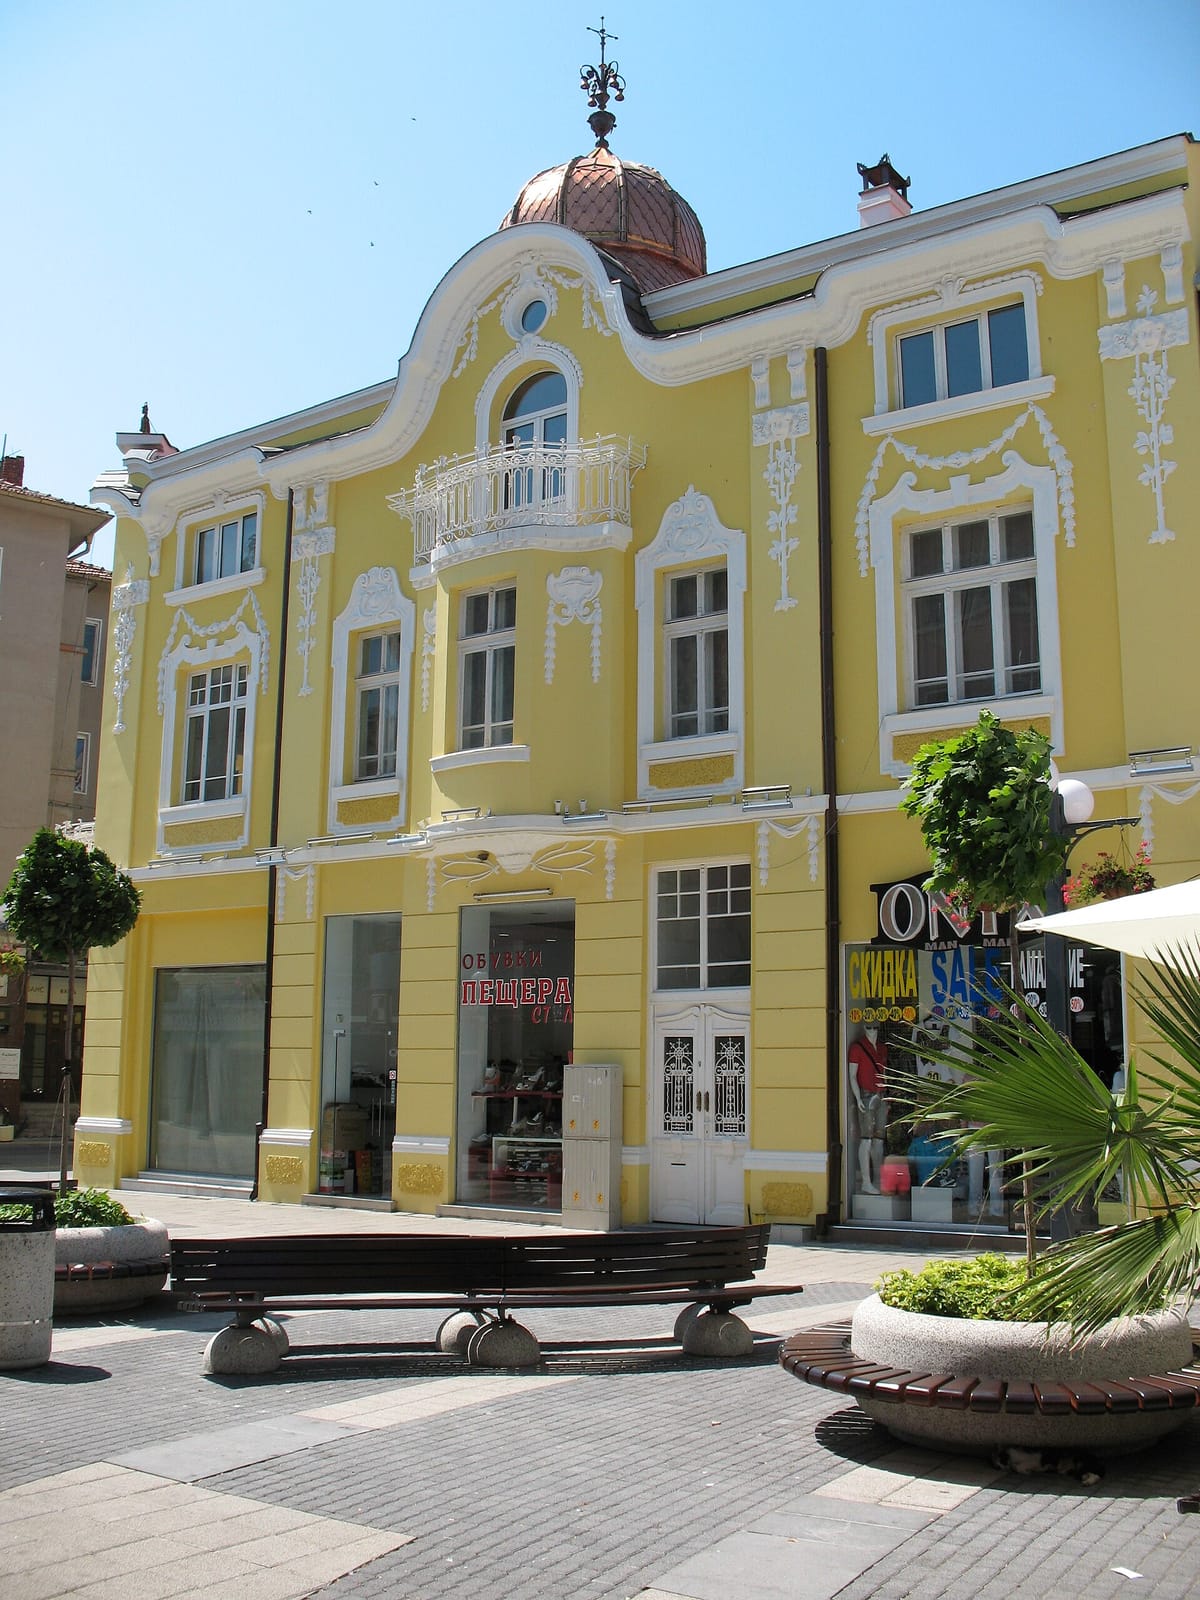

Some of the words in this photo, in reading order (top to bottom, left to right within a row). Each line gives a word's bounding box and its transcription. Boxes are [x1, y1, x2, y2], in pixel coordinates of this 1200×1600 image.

[462, 951, 542, 969] ОБУВКИ
[924, 940, 958, 951] MAN
[850, 950, 918, 1005] СКИДКА
[931, 947, 1003, 1004] SALE
[461, 977, 572, 1008] ПЕЩЕРА
